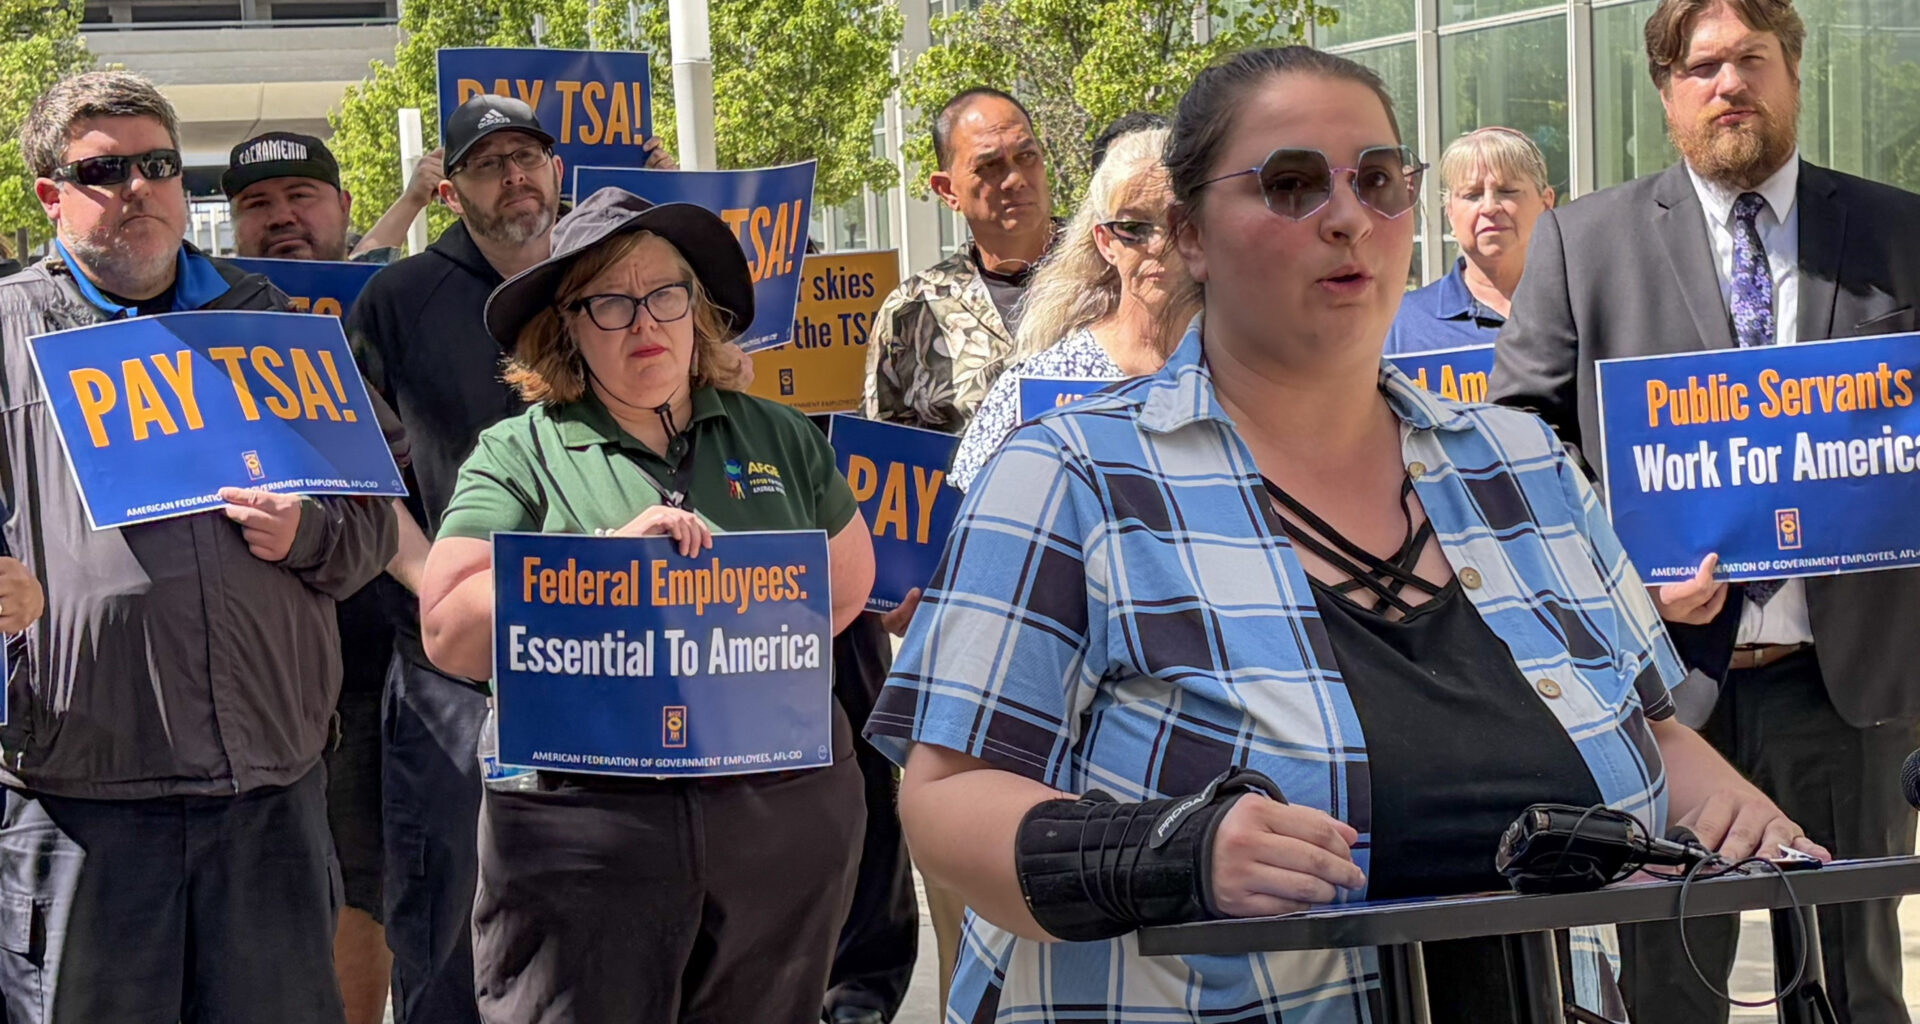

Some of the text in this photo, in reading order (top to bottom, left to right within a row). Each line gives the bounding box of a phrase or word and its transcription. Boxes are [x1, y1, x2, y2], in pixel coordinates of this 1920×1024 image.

[555, 80, 644, 146] TSA!
[239, 139, 308, 165] SACRAMENTO
[812, 266, 876, 301] skies
[794, 316, 832, 350] the
[69, 345, 358, 448] PAY TSA!
[1646, 362, 1914, 427] Public Servants
[1632, 440, 1722, 493] Work
[1729, 436, 1782, 486] For
[126, 502, 175, 517] AMERICAN
[174, 492, 223, 509] FEDERATIO
[847, 454, 945, 544] PAY
[523, 557, 807, 616] Federal Employees:
[1651, 565, 1698, 577] AMERICAN
[1757, 561, 1771, 571] OF
[1772, 556, 1839, 570] GOVERNMENT
[1841, 550, 1898, 565] EMPLOYEES,
[509, 624, 820, 677] Essential To America
[532, 750, 803, 768] AMERICAN FEDERATION OF GOVERNMENT EMPLOYEES, AFL-CIO
